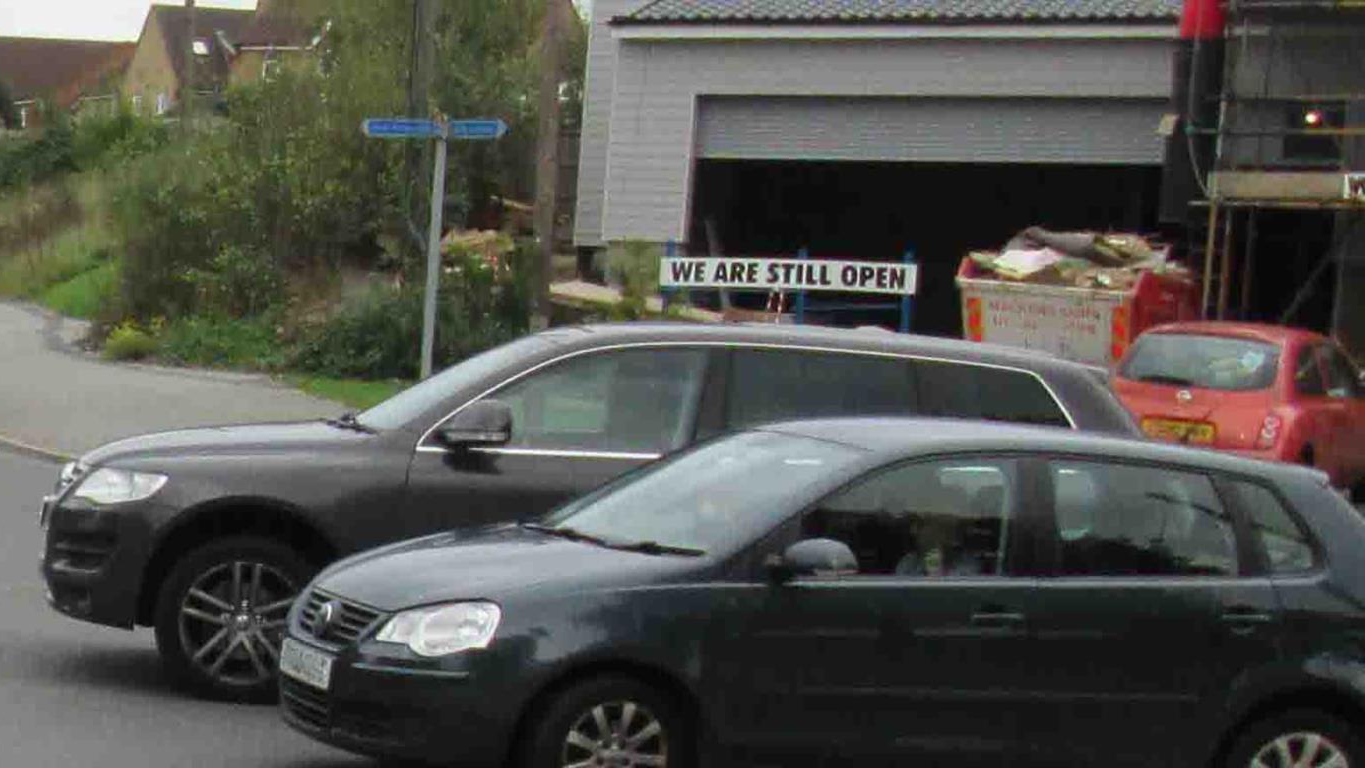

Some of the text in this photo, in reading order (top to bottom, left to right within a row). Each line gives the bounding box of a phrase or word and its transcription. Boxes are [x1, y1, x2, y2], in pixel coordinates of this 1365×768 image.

[671, 261, 906, 289] WE ARE STILL OPEN
